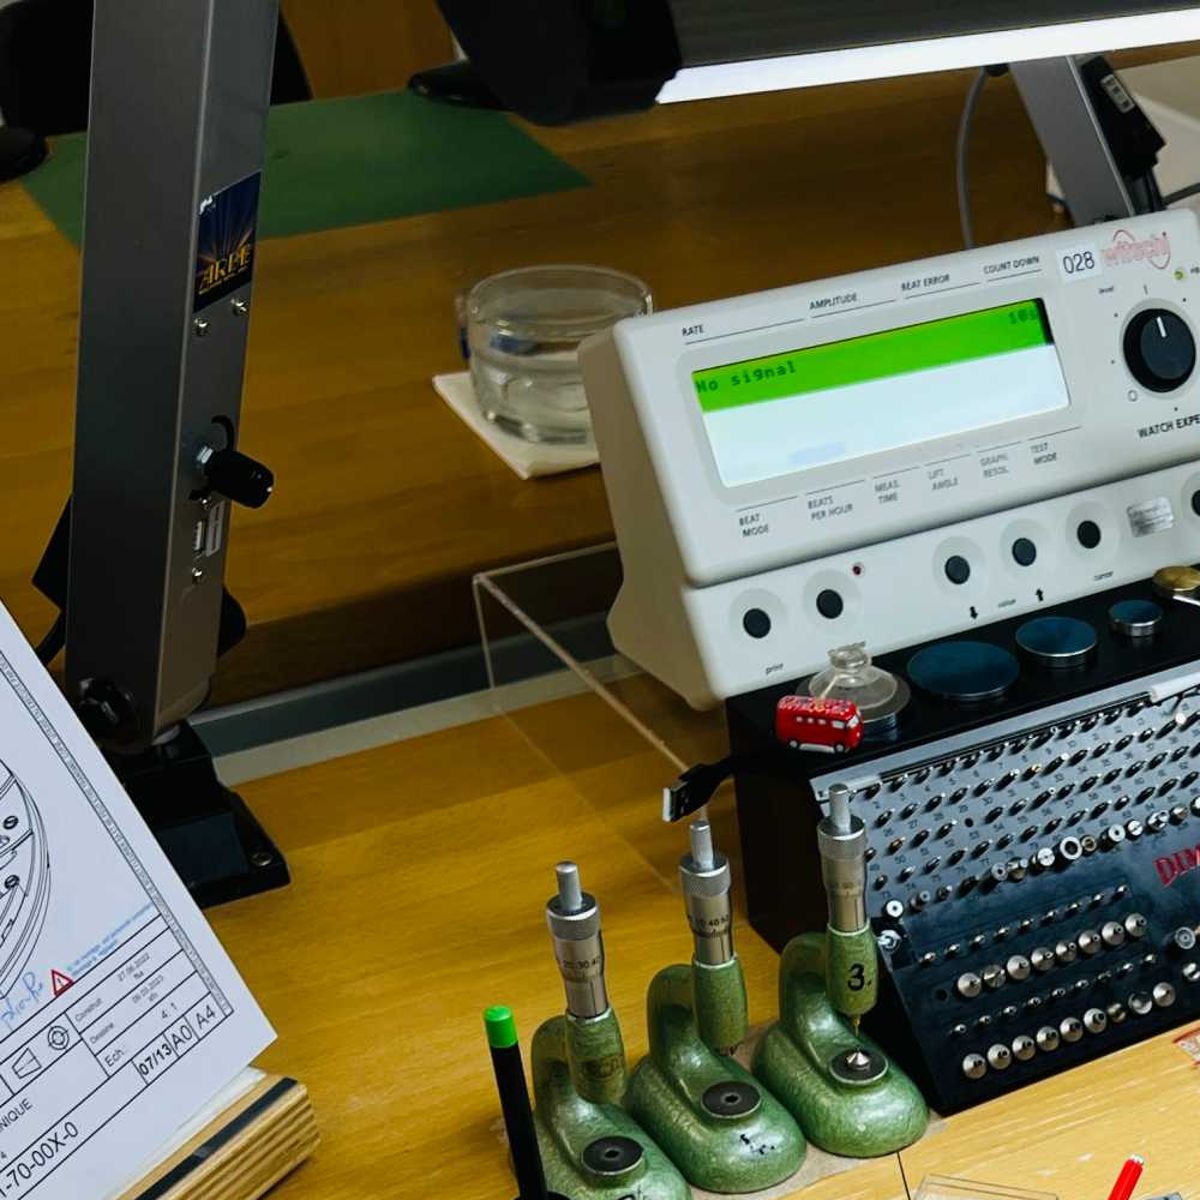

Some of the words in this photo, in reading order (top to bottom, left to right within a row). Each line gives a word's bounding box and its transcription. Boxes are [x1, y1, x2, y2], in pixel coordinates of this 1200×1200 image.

[983, 259, 1012, 275] COUNT
[1012, 254, 1040, 270] DOWN
[1063, 250, 1096, 275] 028
[900, 278, 922, 292] BEAT
[923, 273, 951, 288] ERROR
[809, 292, 858, 311] AMPLITUDE
[681, 323, 705, 337] RATE
[695, 378, 719, 394] No
[731, 359, 797, 387] signal
[1137, 421, 1174, 439] WATCH
[1033, 451, 1058, 466] MODE
[807, 495, 834, 510] BEATS
[738, 512, 760, 526] BEAT
[811, 508, 827, 522] PER
[827, 503, 853, 519] HOUR
[742, 523, 769, 538] MODE
[195, 1004, 217, 1030] A4
[170, 1024, 194, 1051] A0
[139, 1042, 173, 1078] 07/13
